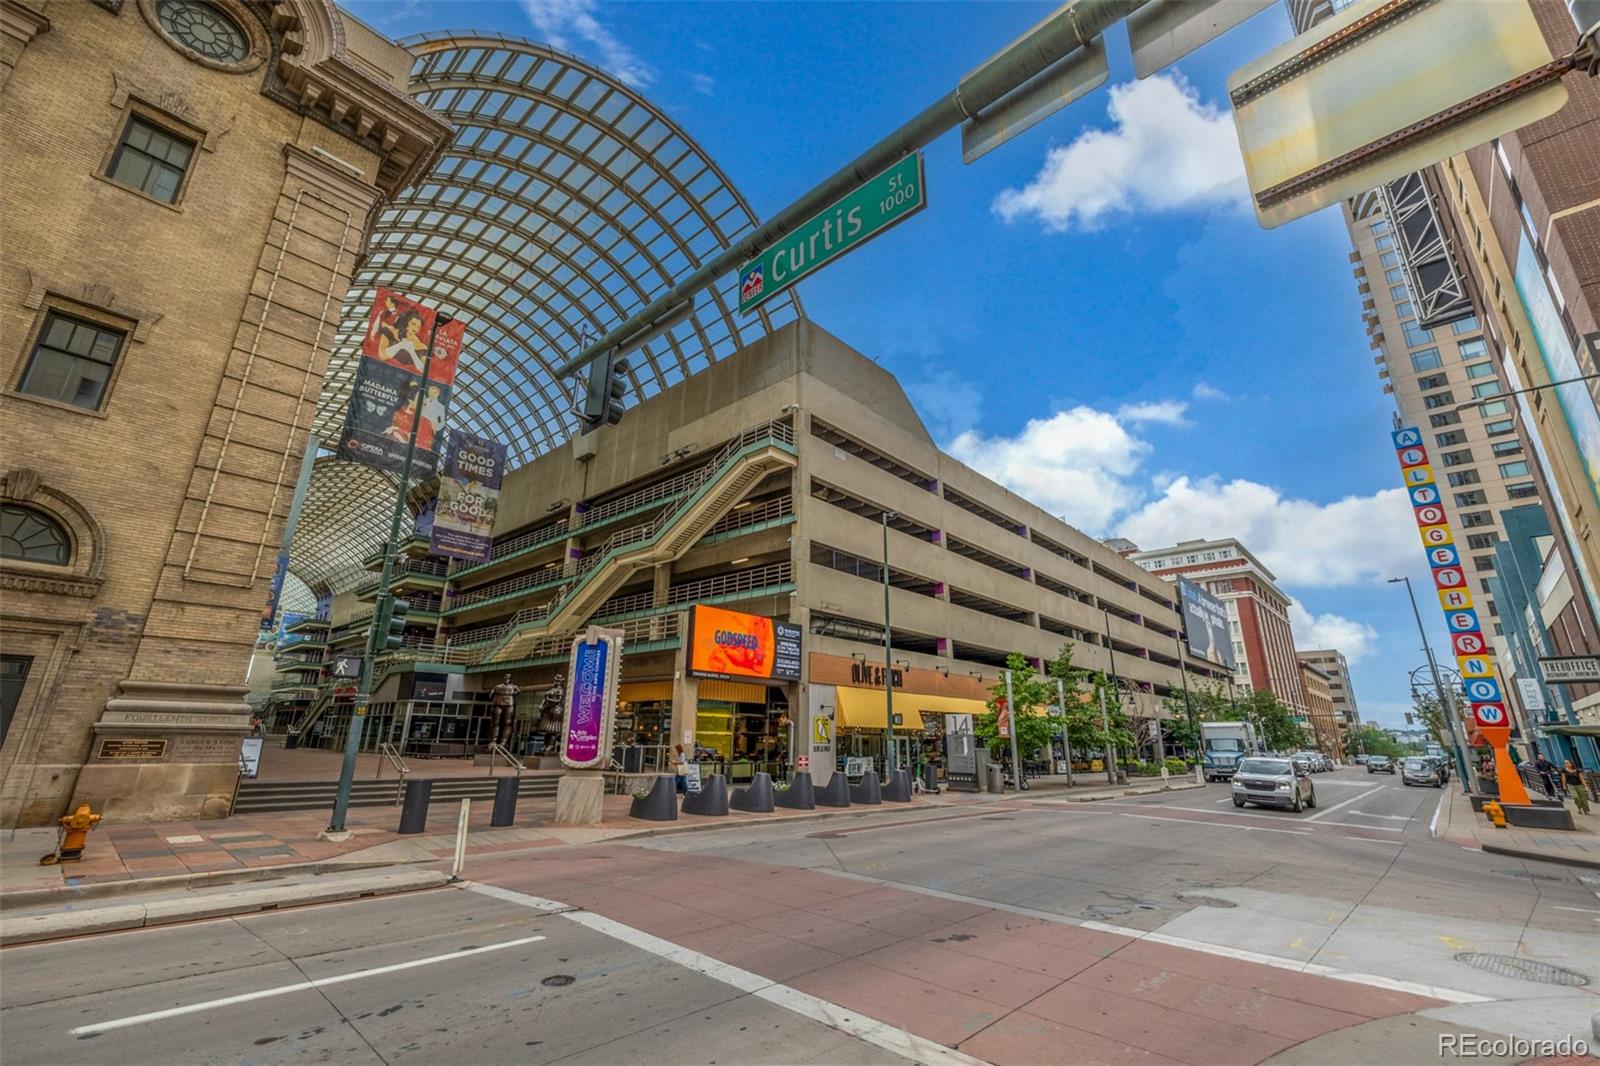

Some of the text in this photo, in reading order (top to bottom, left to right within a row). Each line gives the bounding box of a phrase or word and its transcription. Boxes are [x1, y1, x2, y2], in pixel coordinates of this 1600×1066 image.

[888, 173, 903, 192] St
[879, 183, 915, 214] 1000
[771, 205, 863, 282] Curtis
[360, 385, 399, 402] BUTTERFLY
[363, 379, 398, 396] MADAMA
[361, 443, 383, 452] OPERA
[458, 450, 495, 467] GOOD
[457, 460, 493, 478] TIMES
[457, 492, 484, 506] FOR
[1544, 662, 1560, 672] THE
[1564, 660, 1597, 671] OFFICE
[852, 663, 903, 687] OLIVE & FCH
[577, 648, 597, 725] WELCOME
[124, 713, 193, 723] FOURTEENTH
